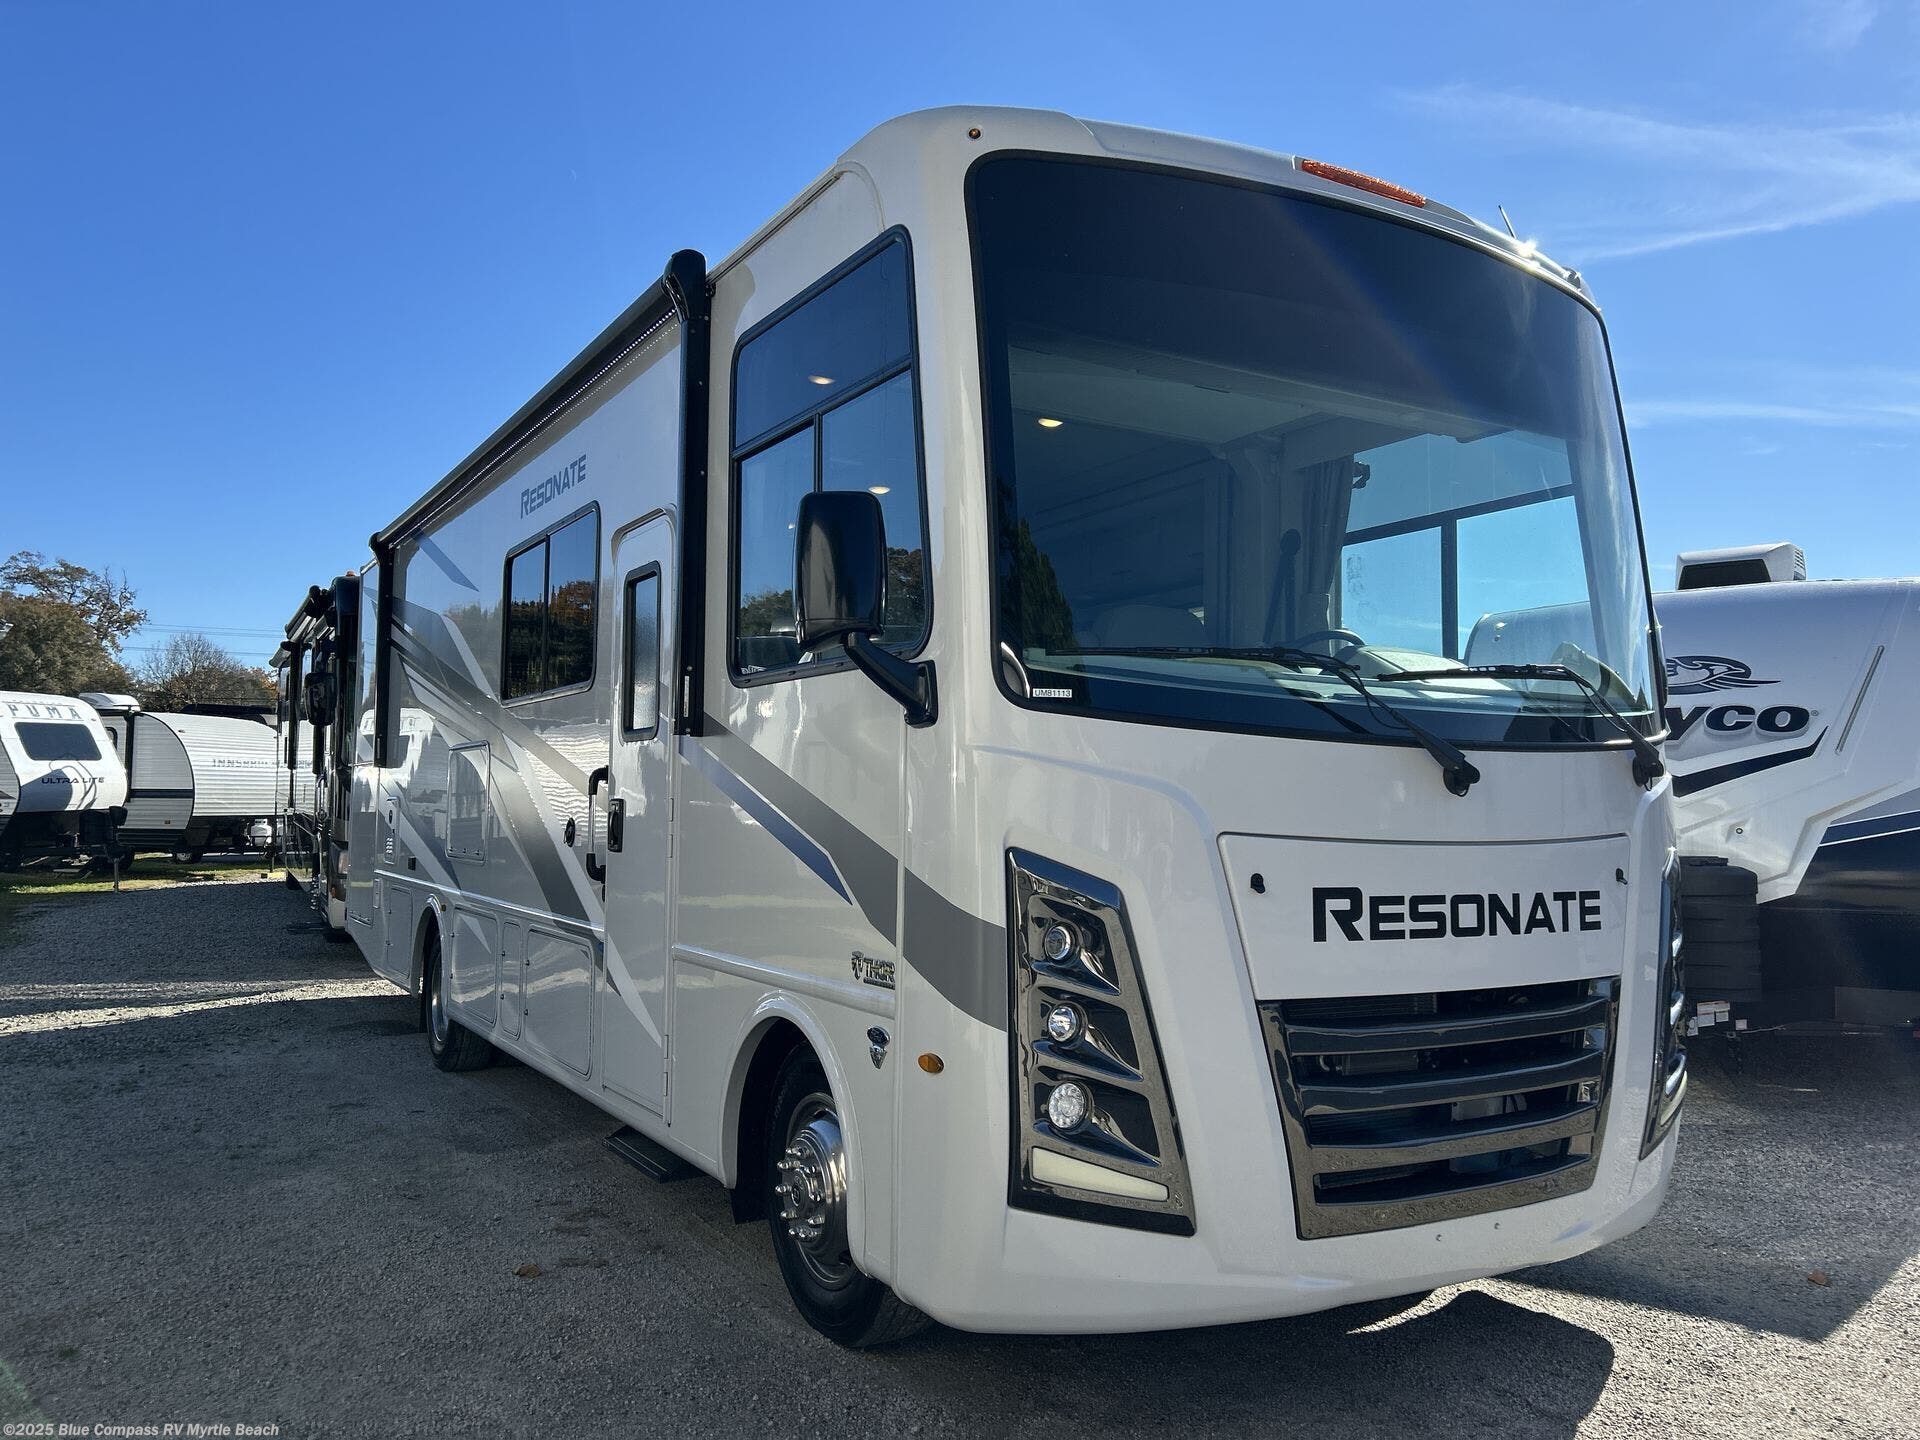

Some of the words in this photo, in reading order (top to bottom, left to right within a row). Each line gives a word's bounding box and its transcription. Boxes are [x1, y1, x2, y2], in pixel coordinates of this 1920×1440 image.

[521, 453, 587, 519] RESONATE
[8, 703, 82, 719] PUMA
[82, 776, 105, 784] LITE
[1312, 887, 1602, 942] RESONATE
